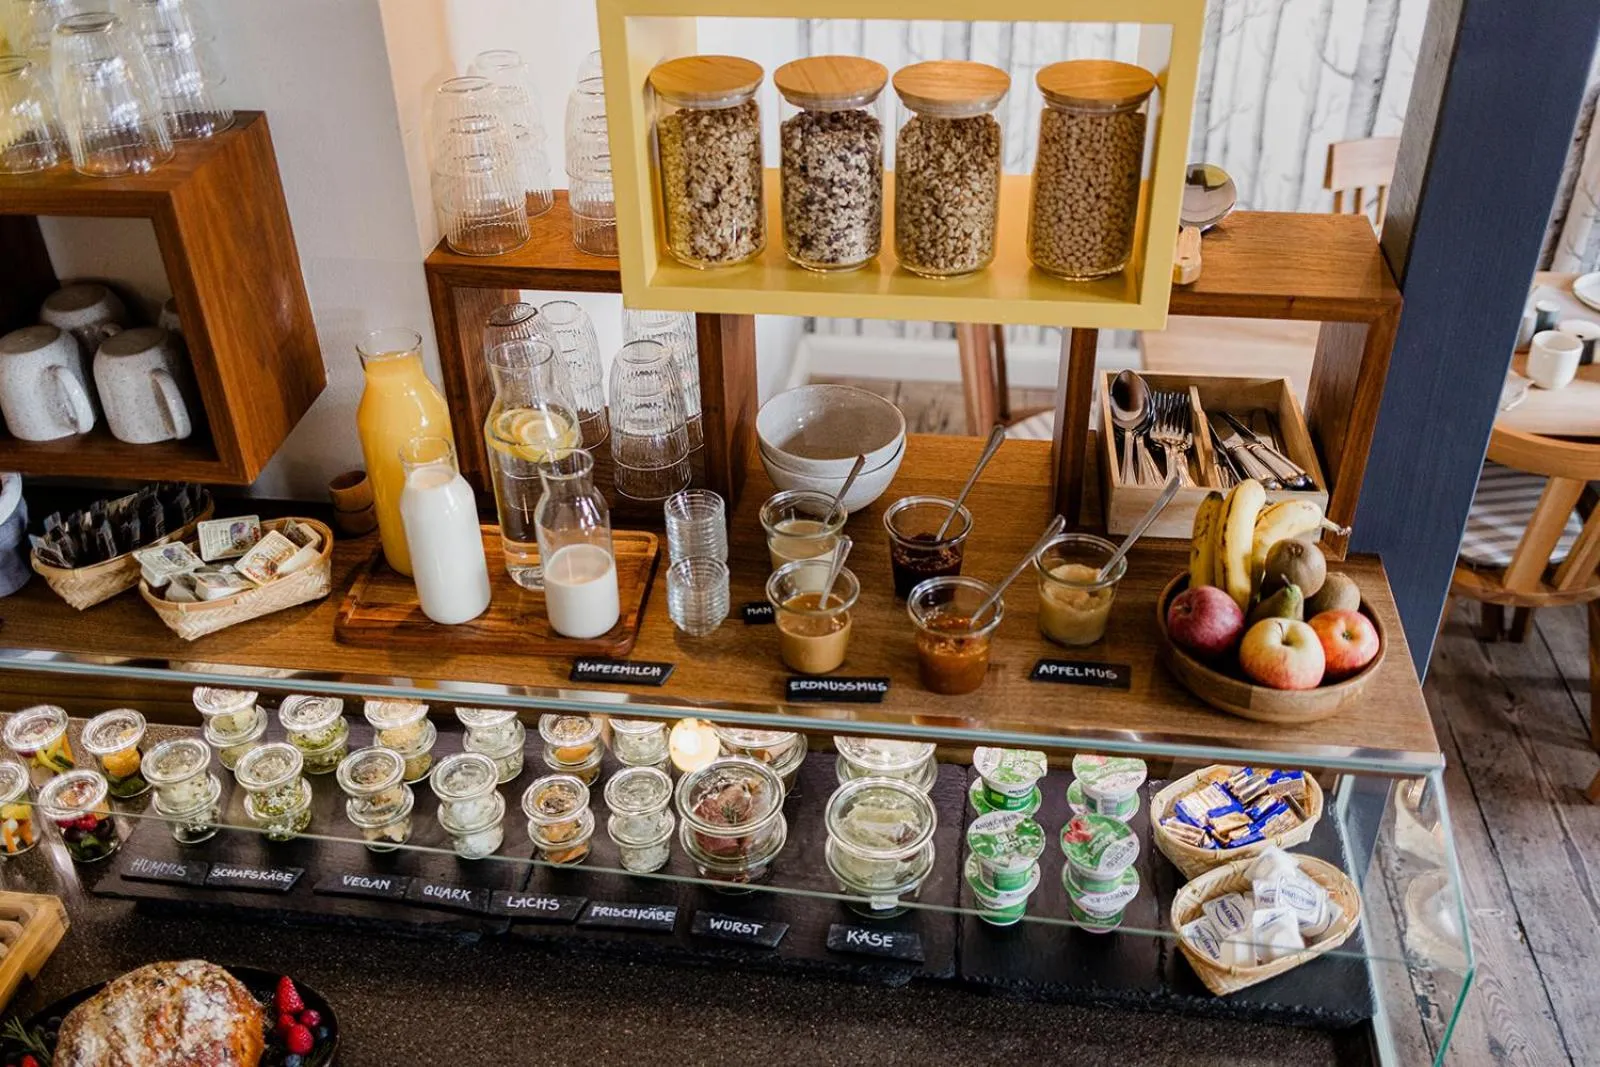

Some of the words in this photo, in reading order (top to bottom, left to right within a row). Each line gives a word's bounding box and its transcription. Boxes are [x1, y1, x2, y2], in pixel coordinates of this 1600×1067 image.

[577, 662, 662, 677] HAFERMILCH
[1038, 664, 1118, 680] APFELMUS
[790, 680, 888, 692] ERDNUSSMUS
[129, 858, 188, 877] HUMMUS
[211, 867, 294, 883] SCHAFSKÄSE
[342, 875, 391, 890] VEGAN
[423, 885, 472, 902] QUARK
[506, 896, 560, 911] LACHS
[591, 906, 676, 922] FRISCHKÄSE
[709, 918, 764, 936] WURST
[846, 929, 894, 948] KÄSE
